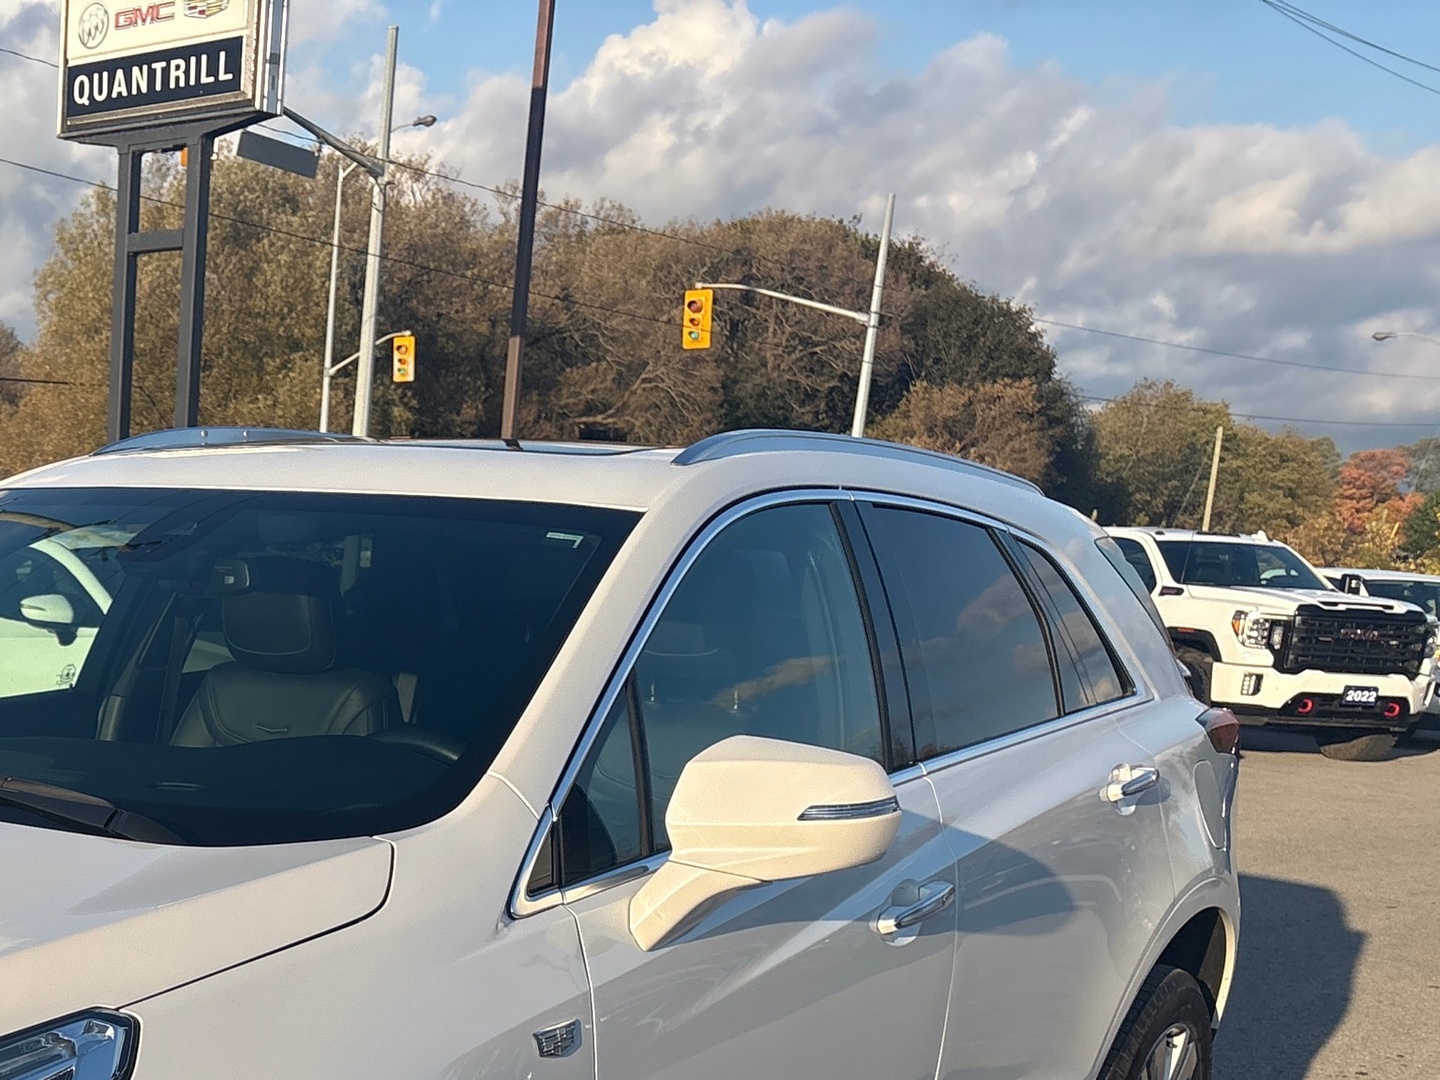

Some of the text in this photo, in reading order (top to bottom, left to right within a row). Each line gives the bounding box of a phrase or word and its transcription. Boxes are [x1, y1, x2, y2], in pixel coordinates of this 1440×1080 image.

[114, 1, 175, 30] GMC
[73, 50, 233, 106] QUANTRILL
[1345, 689, 1377, 702] 2022
